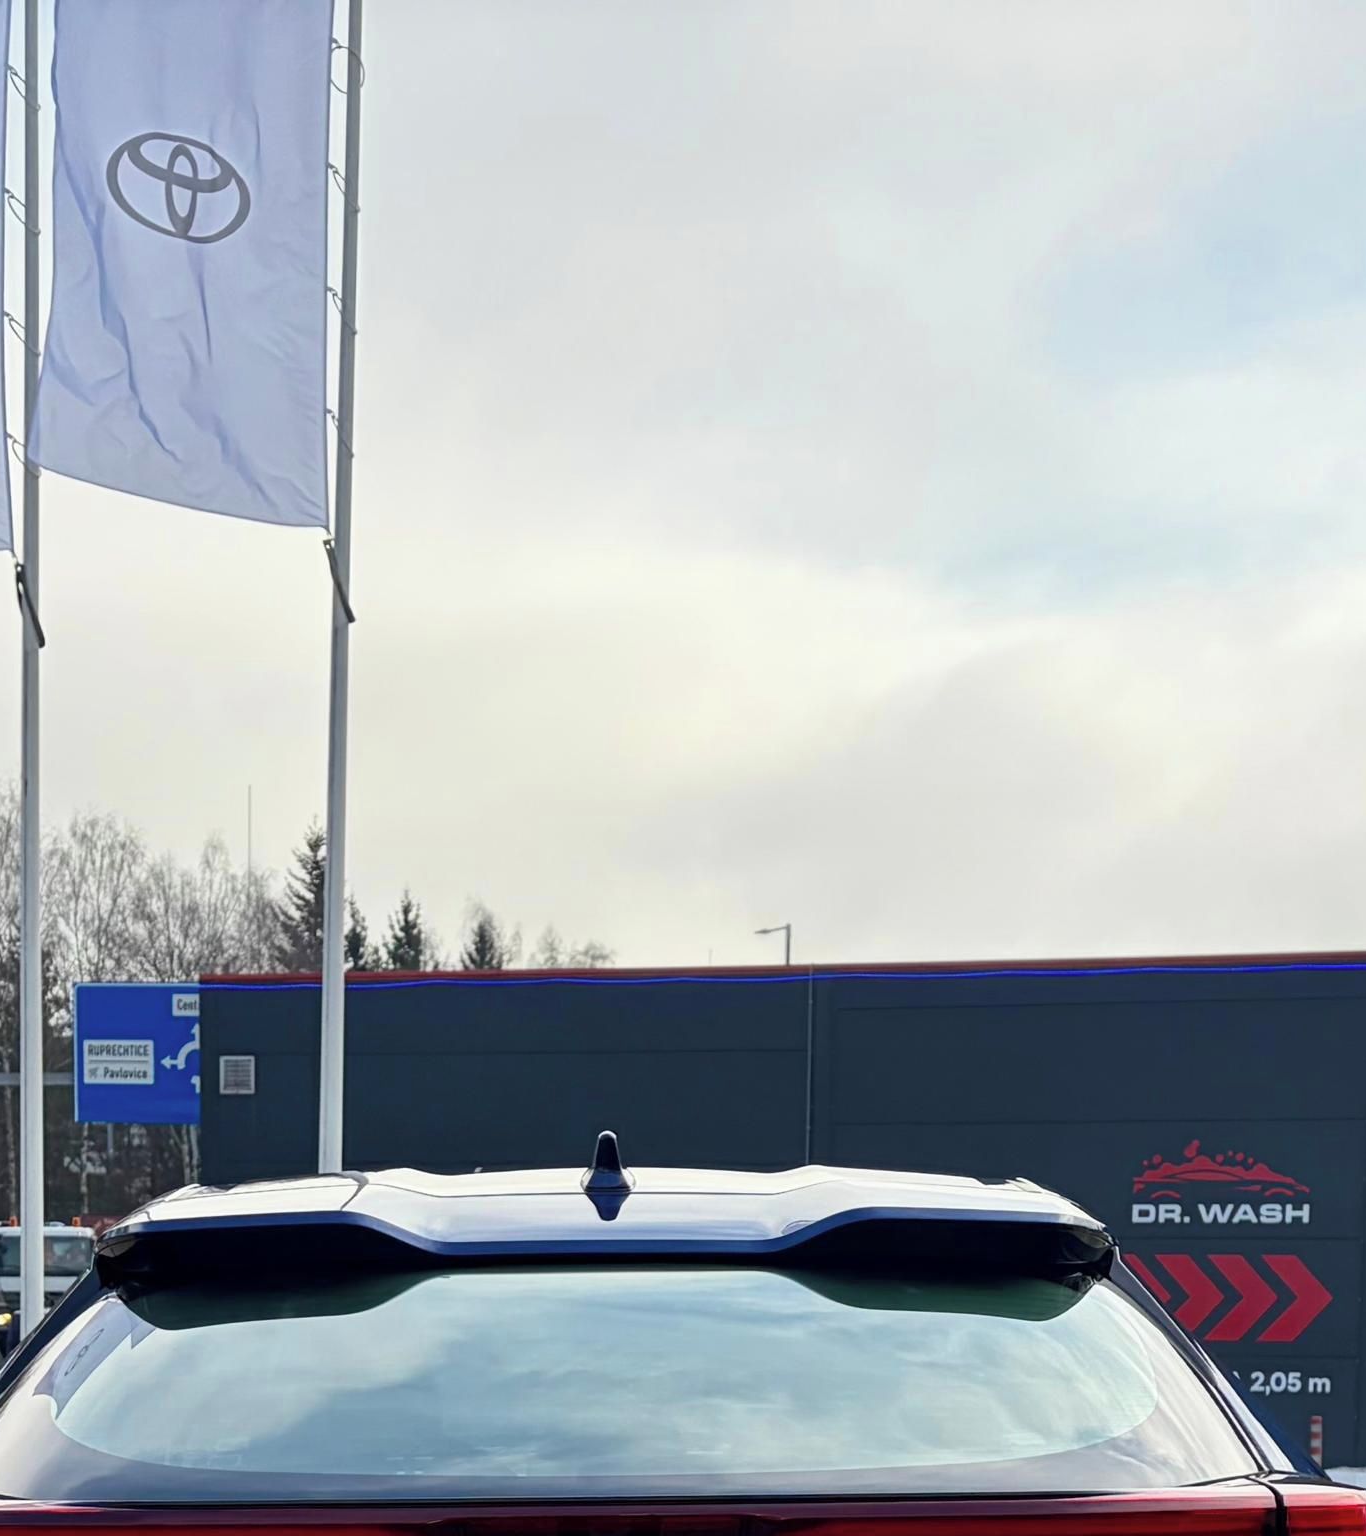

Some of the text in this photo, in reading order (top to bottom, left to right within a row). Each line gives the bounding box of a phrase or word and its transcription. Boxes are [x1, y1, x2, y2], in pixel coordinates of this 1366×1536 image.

[87, 1044, 149, 1057] RUPRECHTICE
[103, 1067, 148, 1079] Pavlovice
[1131, 1203, 1311, 1224] DR. WASH
[1249, 1371, 1302, 1396] 2,05
[1308, 1377, 1332, 1393] m
